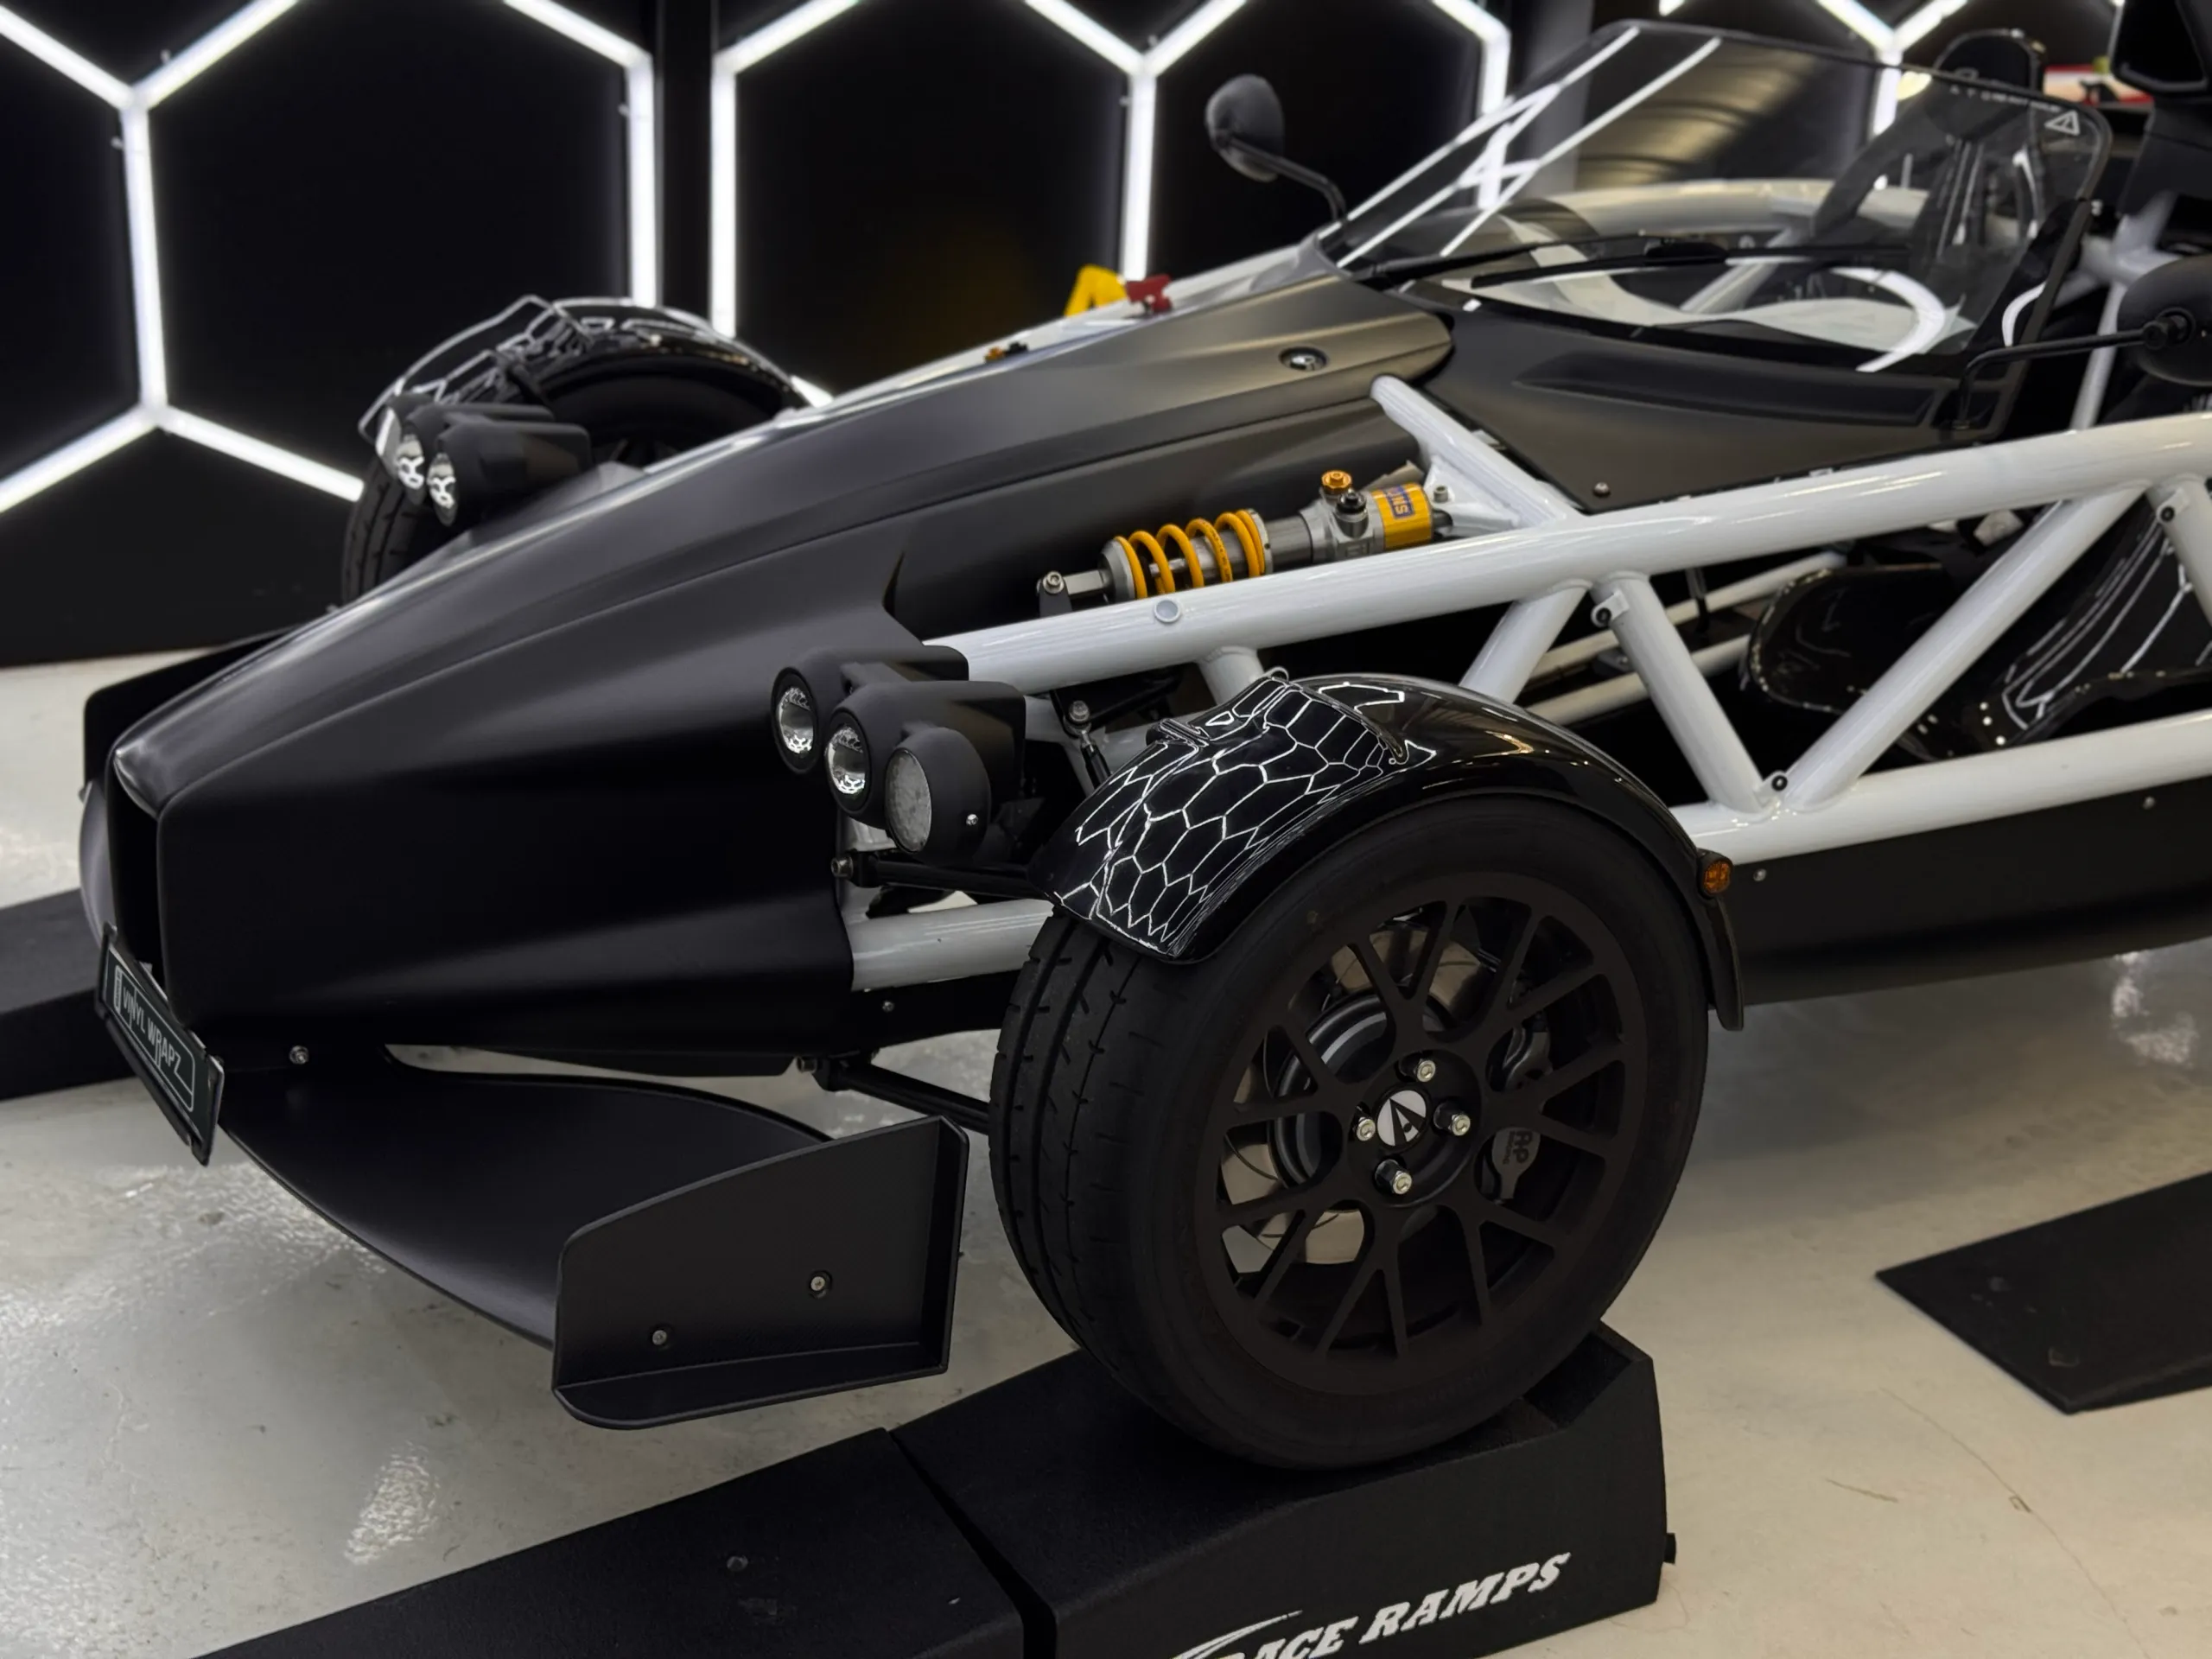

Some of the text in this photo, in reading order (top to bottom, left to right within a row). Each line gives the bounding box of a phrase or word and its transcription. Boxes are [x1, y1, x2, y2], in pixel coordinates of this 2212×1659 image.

[123, 986, 181, 1073] VINYL WRAPZ
[1219, 1552, 1572, 1659] ACE RAMPS
